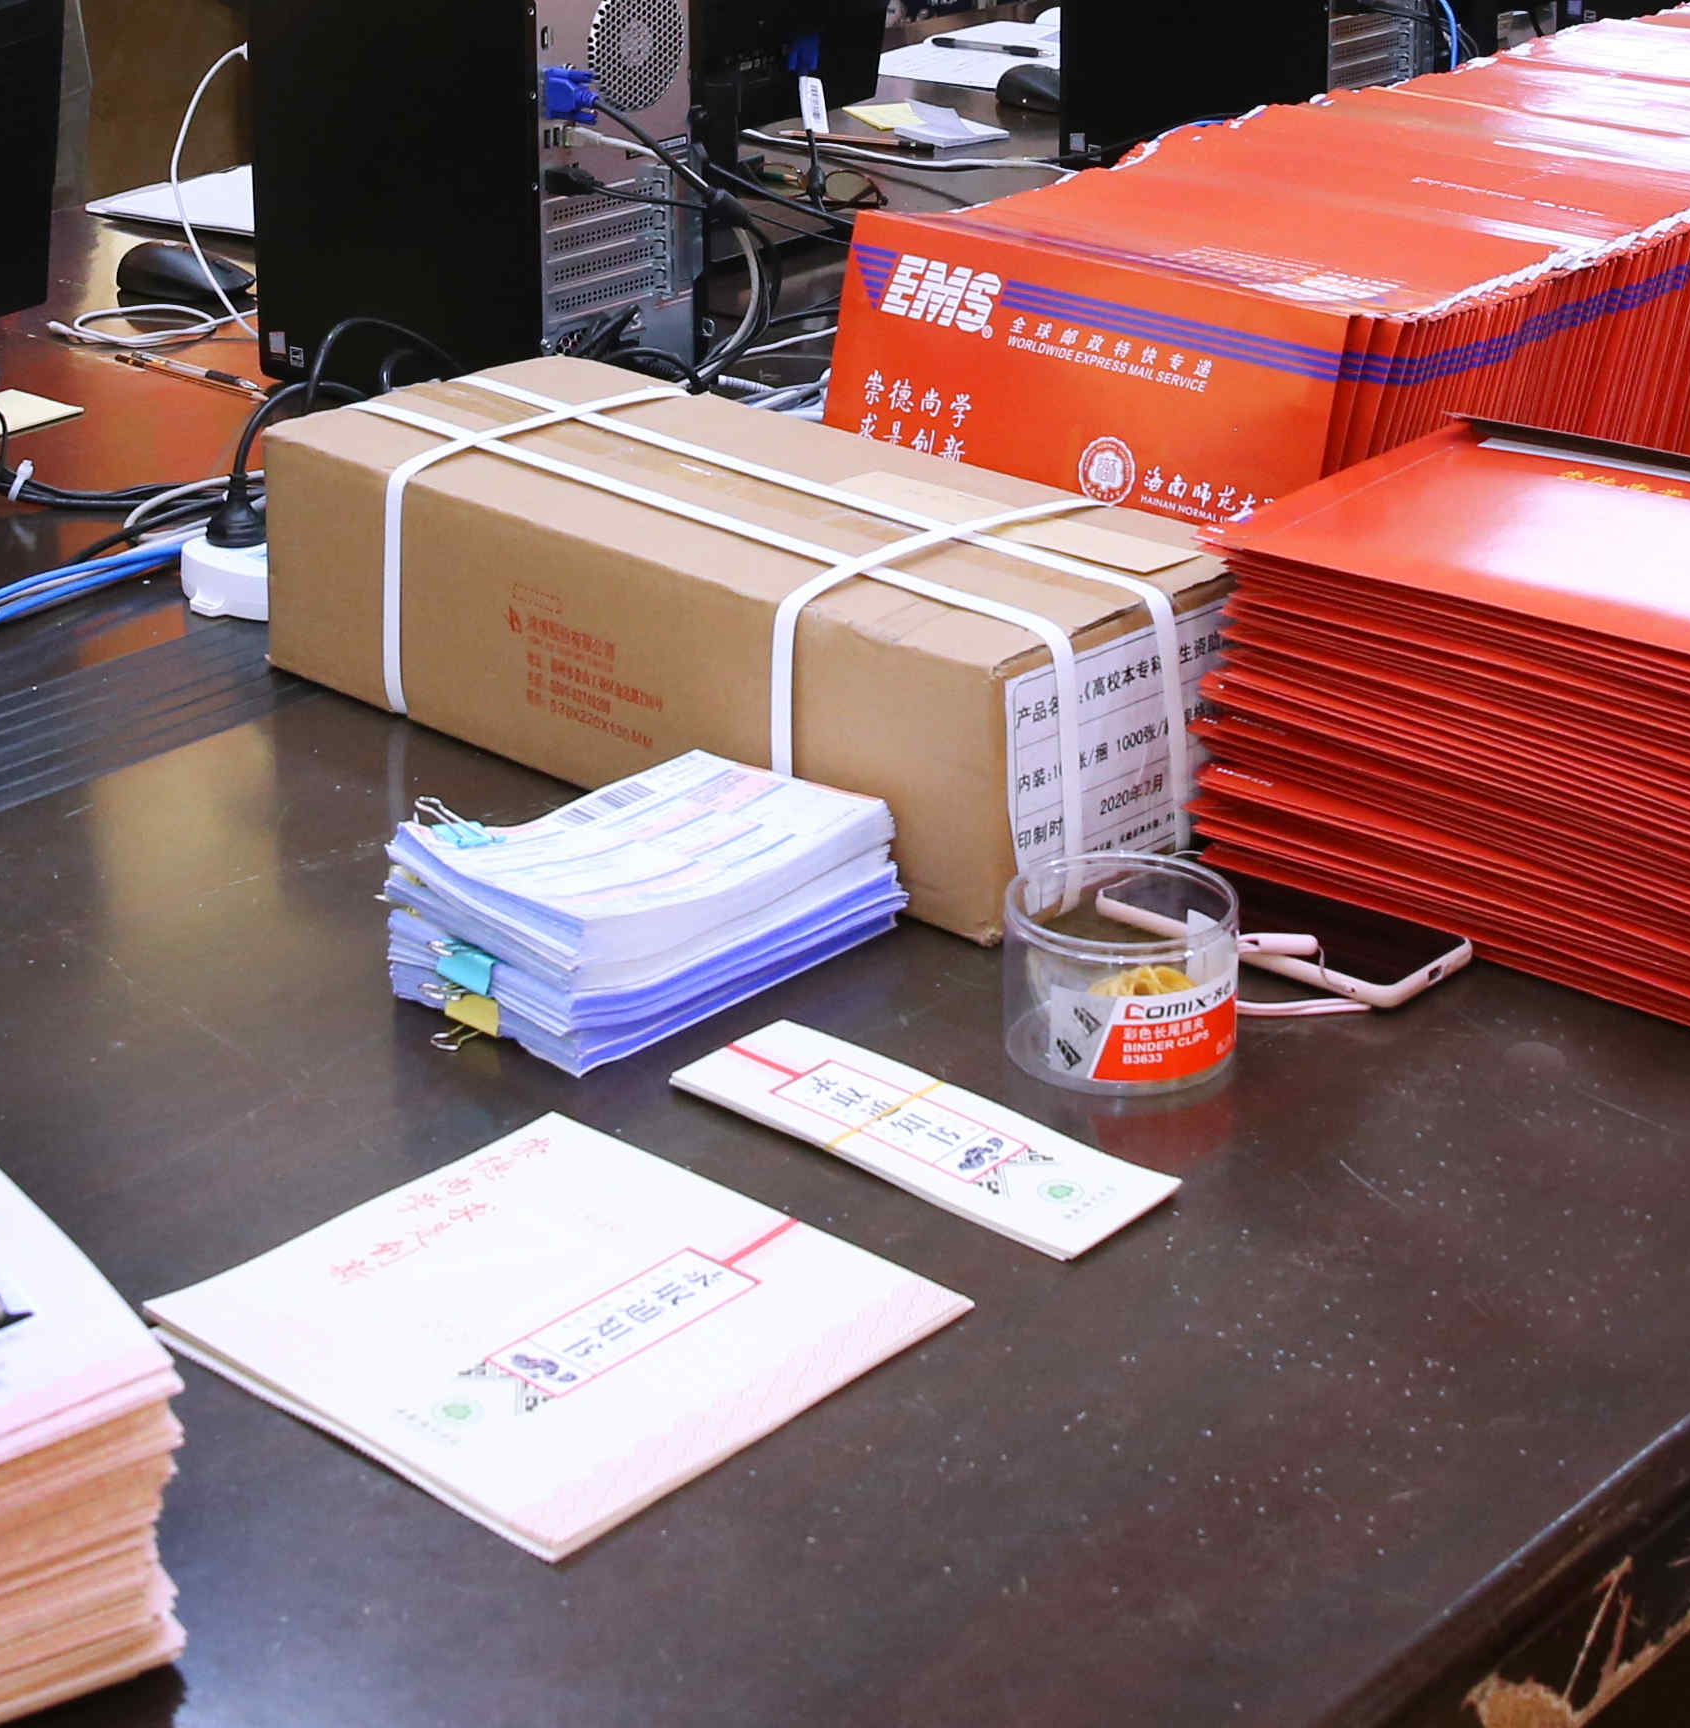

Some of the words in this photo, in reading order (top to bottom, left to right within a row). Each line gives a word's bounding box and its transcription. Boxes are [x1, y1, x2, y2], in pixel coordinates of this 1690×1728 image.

[880, 254, 1002, 334] EMS
[1007, 335, 1074, 362] WORLDWIDE
[1074, 350, 1128, 375] EXPRESS
[1127, 365, 1155, 382] MAIL
[1155, 369, 1207, 393] SERVICE
[1009, 316, 1213, 379] 全球邮政特快专递
[863, 369, 973, 429] 崇德尚学
[1140, 494, 1176, 512] HAINAN
[1177, 503, 1217, 523] NORMAL
[1122, 1036, 1175, 1053] BINDER
[1176, 1029, 1210, 1048] CLIPS
[1122, 1052, 1163, 1066] B3633
